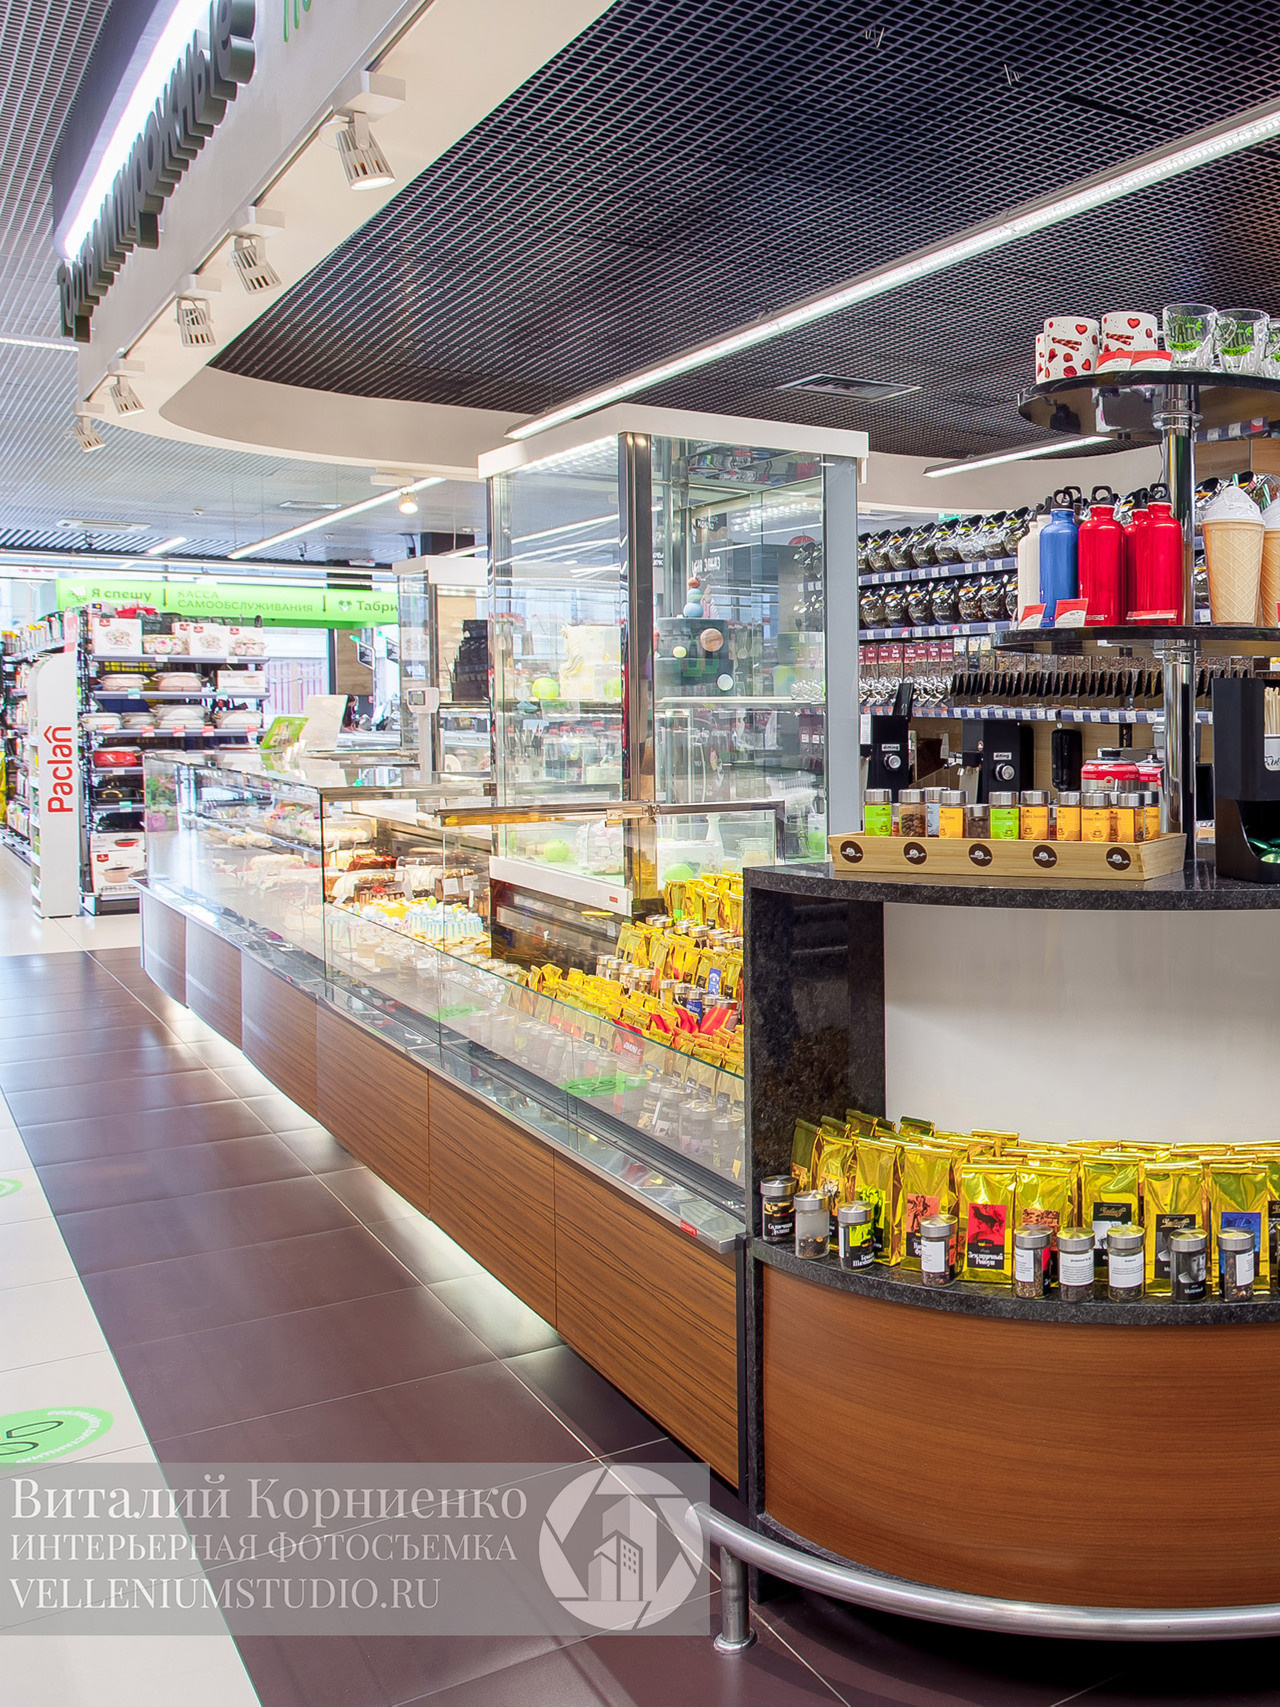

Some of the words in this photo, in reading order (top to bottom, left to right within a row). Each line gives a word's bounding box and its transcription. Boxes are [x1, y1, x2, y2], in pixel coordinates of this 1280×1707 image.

[92, 588, 101, 599] Я
[104, 590, 153, 601] спешу
[178, 590, 220, 600] КАССА
[178, 599, 314, 613] САМООБСЛУЖИВАНИЯ
[44, 726, 74, 813] Paclan
